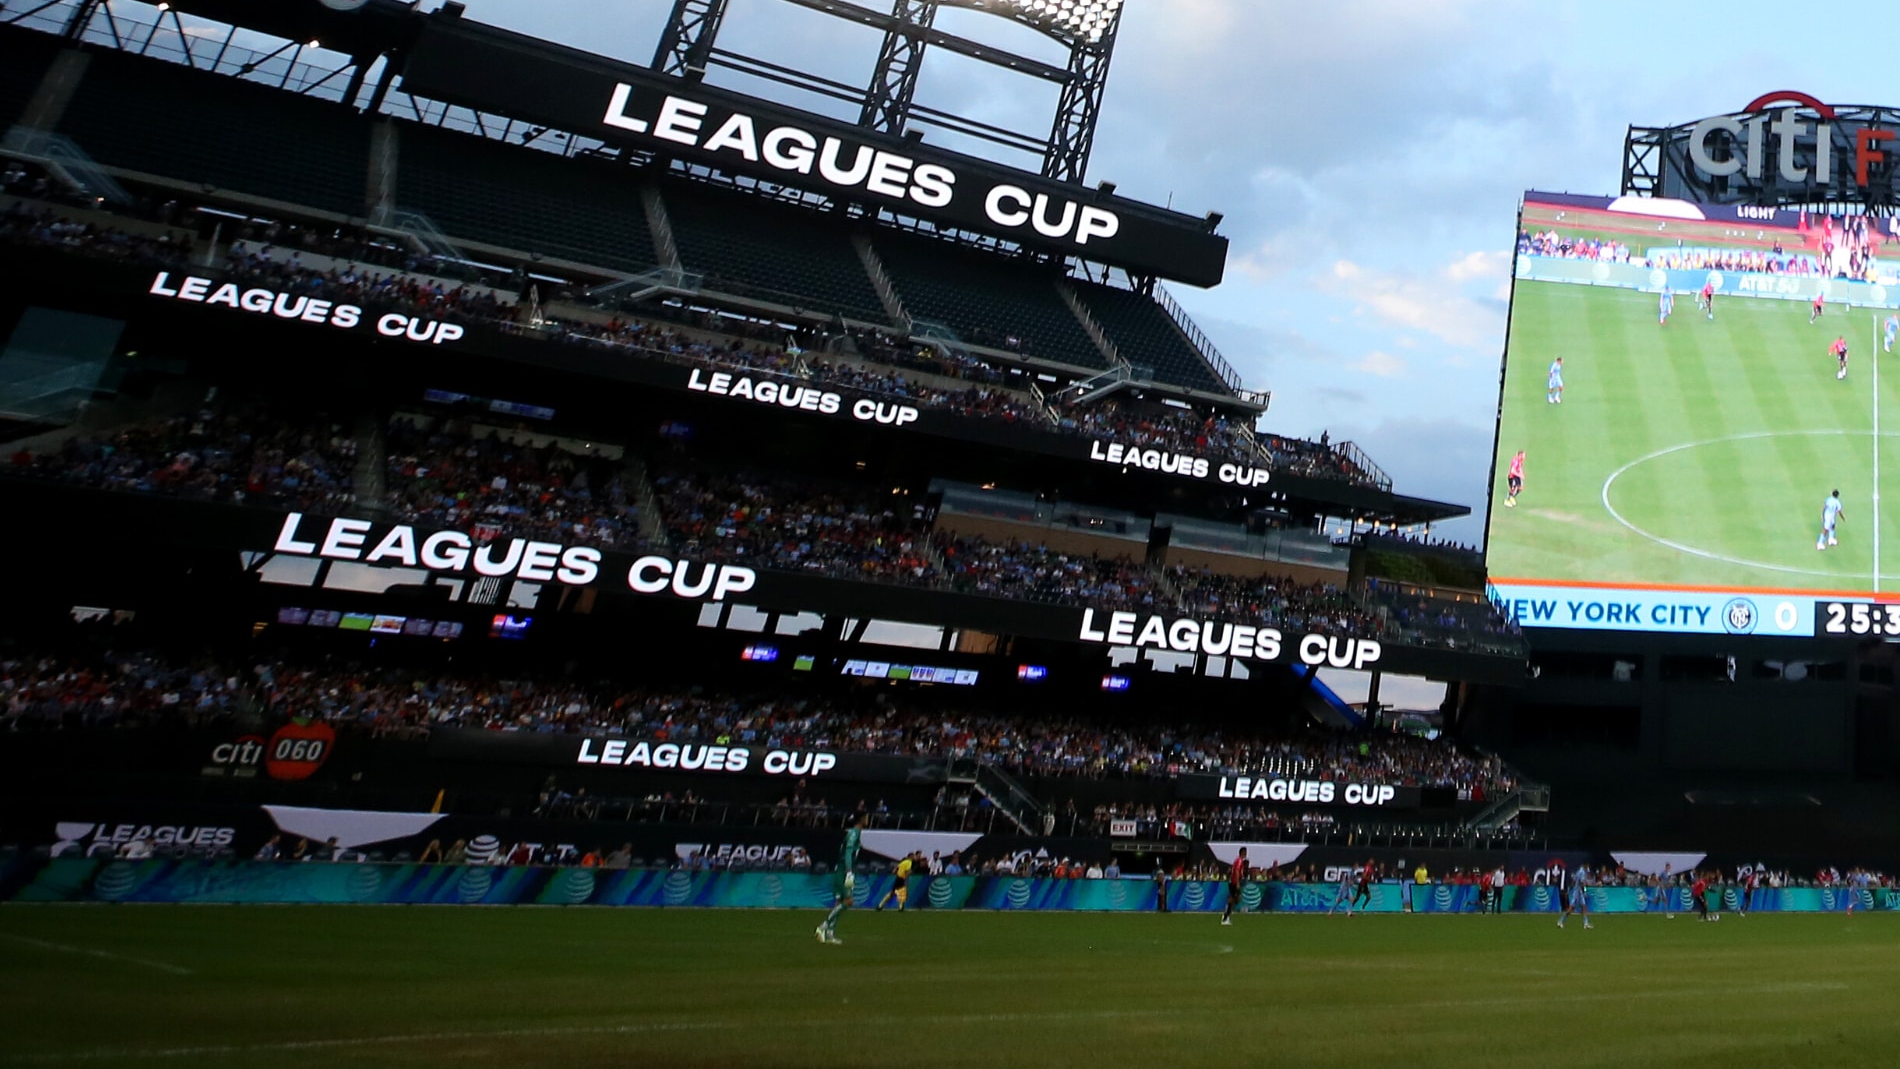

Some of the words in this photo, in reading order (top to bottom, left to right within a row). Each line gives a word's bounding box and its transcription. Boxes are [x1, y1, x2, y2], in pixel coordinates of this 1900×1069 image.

[603, 83, 957, 207] LEAGUES
[985, 185, 1120, 244] CUP
[1688, 110, 1831, 184] citi
[1737, 205, 1777, 221] LIGHT
[150, 272, 361, 327] LEAGUES
[377, 314, 464, 344] CUP
[687, 369, 840, 414] LEAGUES
[853, 400, 918, 426] CUP
[1090, 441, 1208, 478] LEAGUES
[1218, 463, 1270, 488] CUP
[275, 512, 601, 585] LEAGUES
[628, 556, 756, 600] CUP
[1567, 601, 1642, 624] YORK
[1651, 604, 1712, 626] CITY
[1775, 601, 1799, 631] 0
[1080, 607, 1282, 660] LEAGUES
[1300, 634, 1381, 669] CUP
[211, 740, 264, 765] citi
[275, 739, 323, 761] 060
[577, 739, 750, 771] LEAGUES
[763, 751, 836, 776] CUP
[1219, 777, 1335, 803] LEAGUES
[1345, 784, 1395, 806] CUP
[94, 823, 236, 845] LEAGUES
[1112, 823, 1134, 832] EXIT
